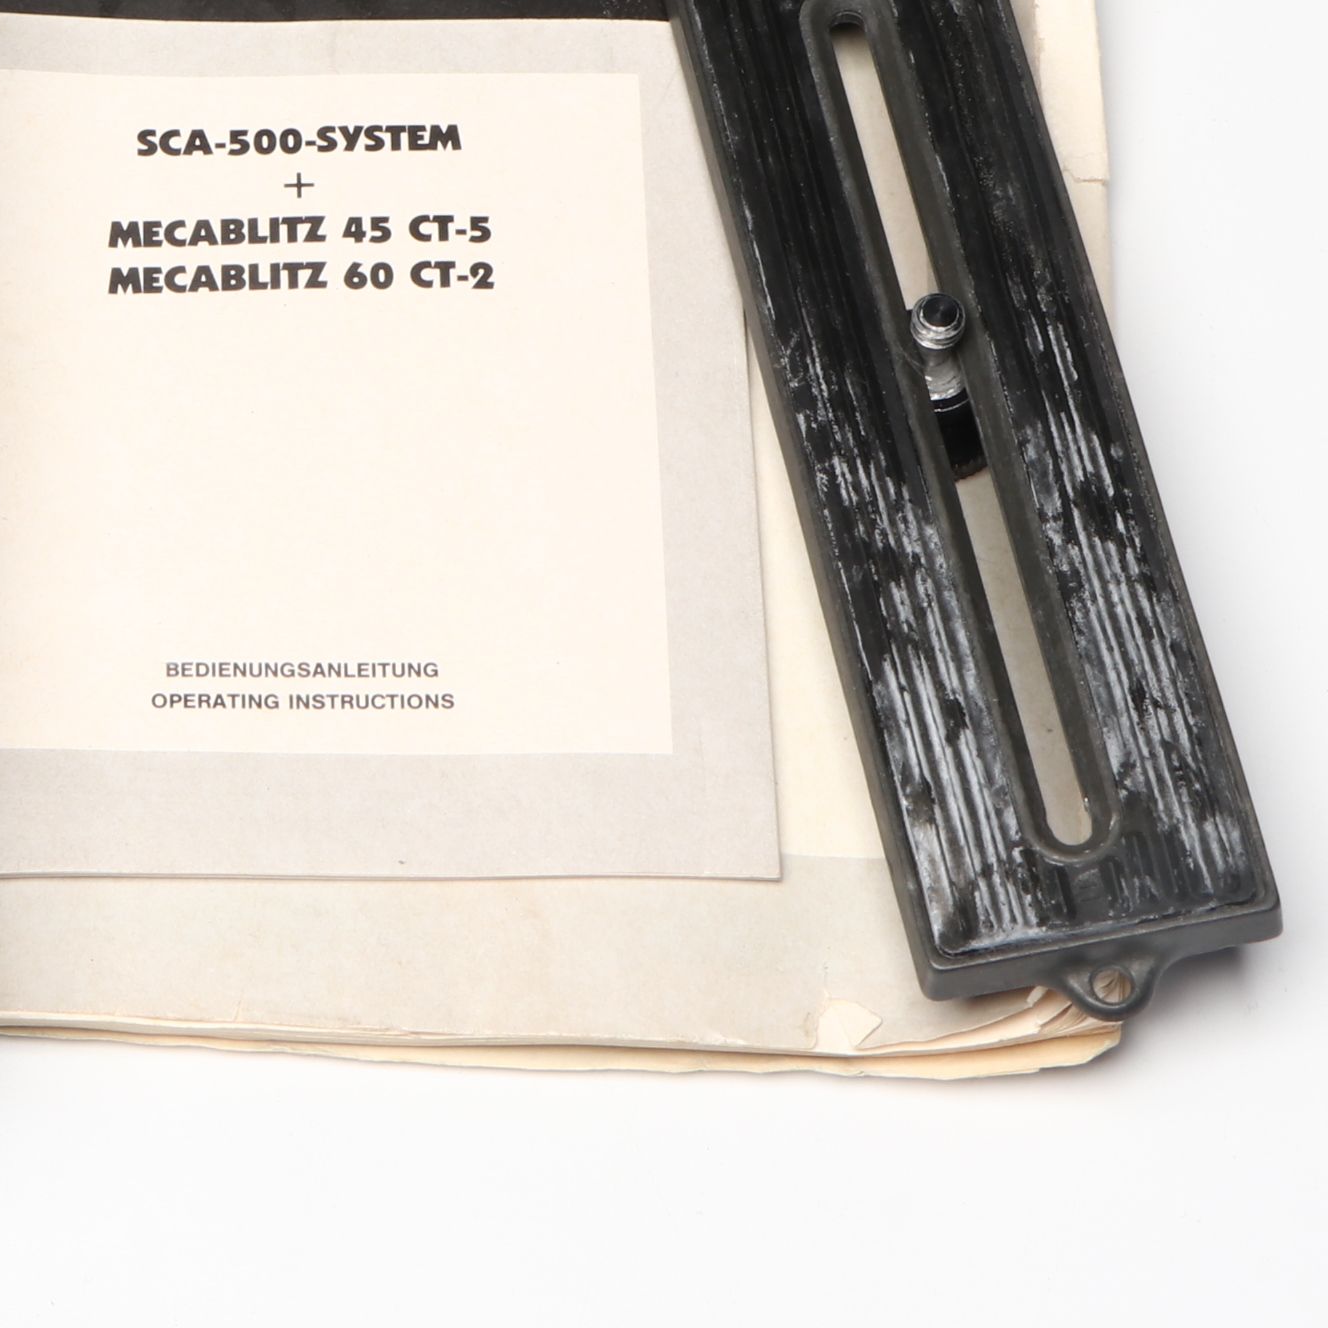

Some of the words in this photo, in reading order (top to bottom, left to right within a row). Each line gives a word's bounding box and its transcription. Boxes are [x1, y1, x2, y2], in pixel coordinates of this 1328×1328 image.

[136, 124, 462, 157] SCA-500-SYSTEM
[284, 172, 315, 198] +
[108, 215, 327, 248] MECABLITZ
[341, 216, 392, 243] 45
[408, 214, 492, 243] CT-5
[108, 261, 328, 294] MECABLITZ
[343, 261, 394, 290] 60
[410, 260, 495, 289] CT-2
[165, 662, 440, 678] BEDIENUNGSANLEITUNG
[151, 693, 280, 709] OPERATING
[288, 693, 455, 710] INSTRUCTIONS
